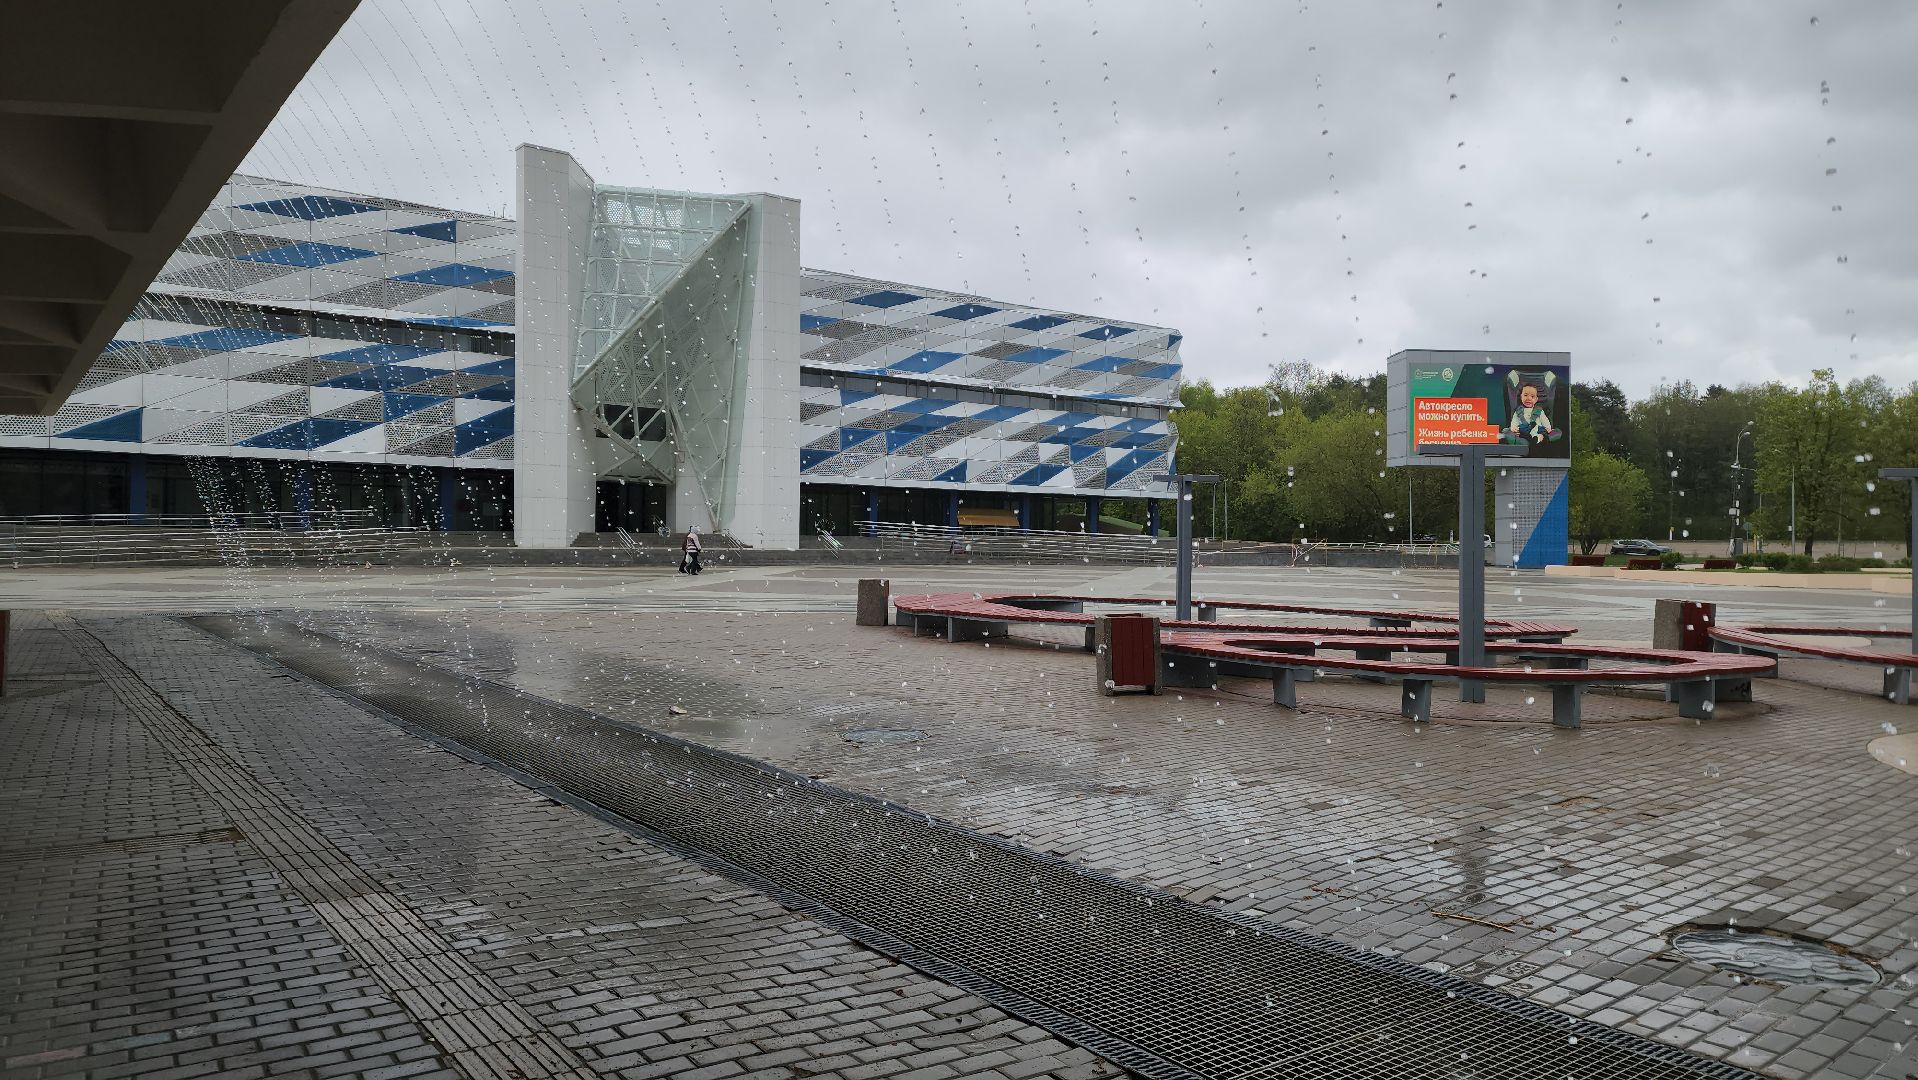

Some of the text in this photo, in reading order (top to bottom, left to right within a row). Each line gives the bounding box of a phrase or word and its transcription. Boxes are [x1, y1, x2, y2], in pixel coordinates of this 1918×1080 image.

[1418, 401, 1473, 412] Автокресло
[1418, 413, 1485, 422] можно купить.
[1418, 428, 1449, 437] Жизнь
[1450, 428, 1488, 439] ребенка
